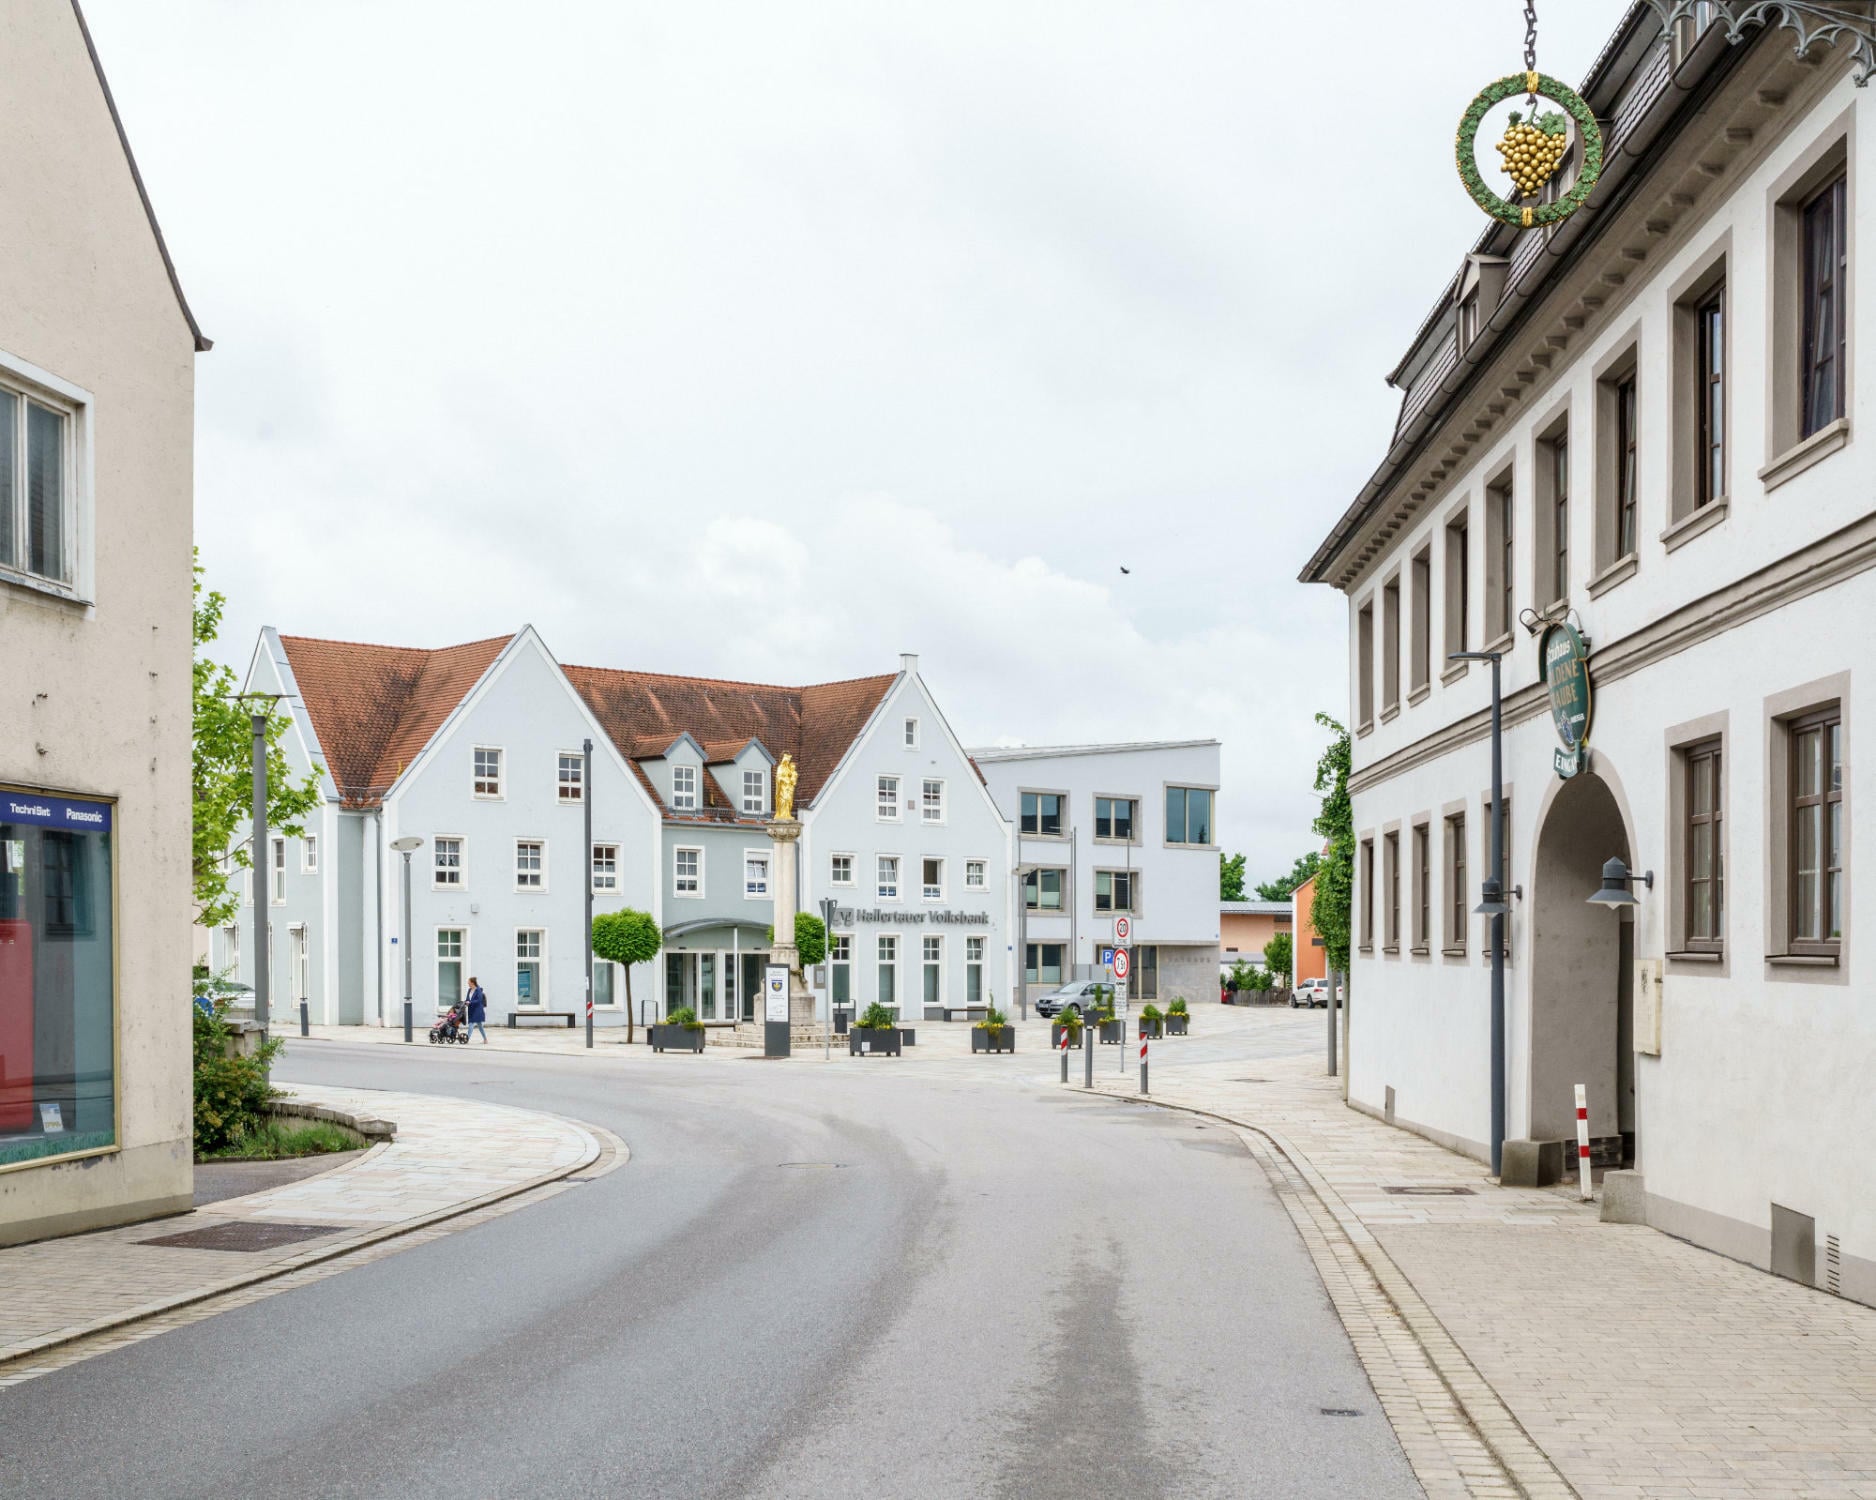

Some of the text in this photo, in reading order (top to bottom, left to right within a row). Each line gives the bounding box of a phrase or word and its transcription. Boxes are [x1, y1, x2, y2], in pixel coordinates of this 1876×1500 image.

[9, 802, 51, 817] TechniSat
[66, 807, 103, 823] Panasonic
[856, 909, 989, 925] Hallertauer Volksbank
[1104, 951, 1112, 963] P
